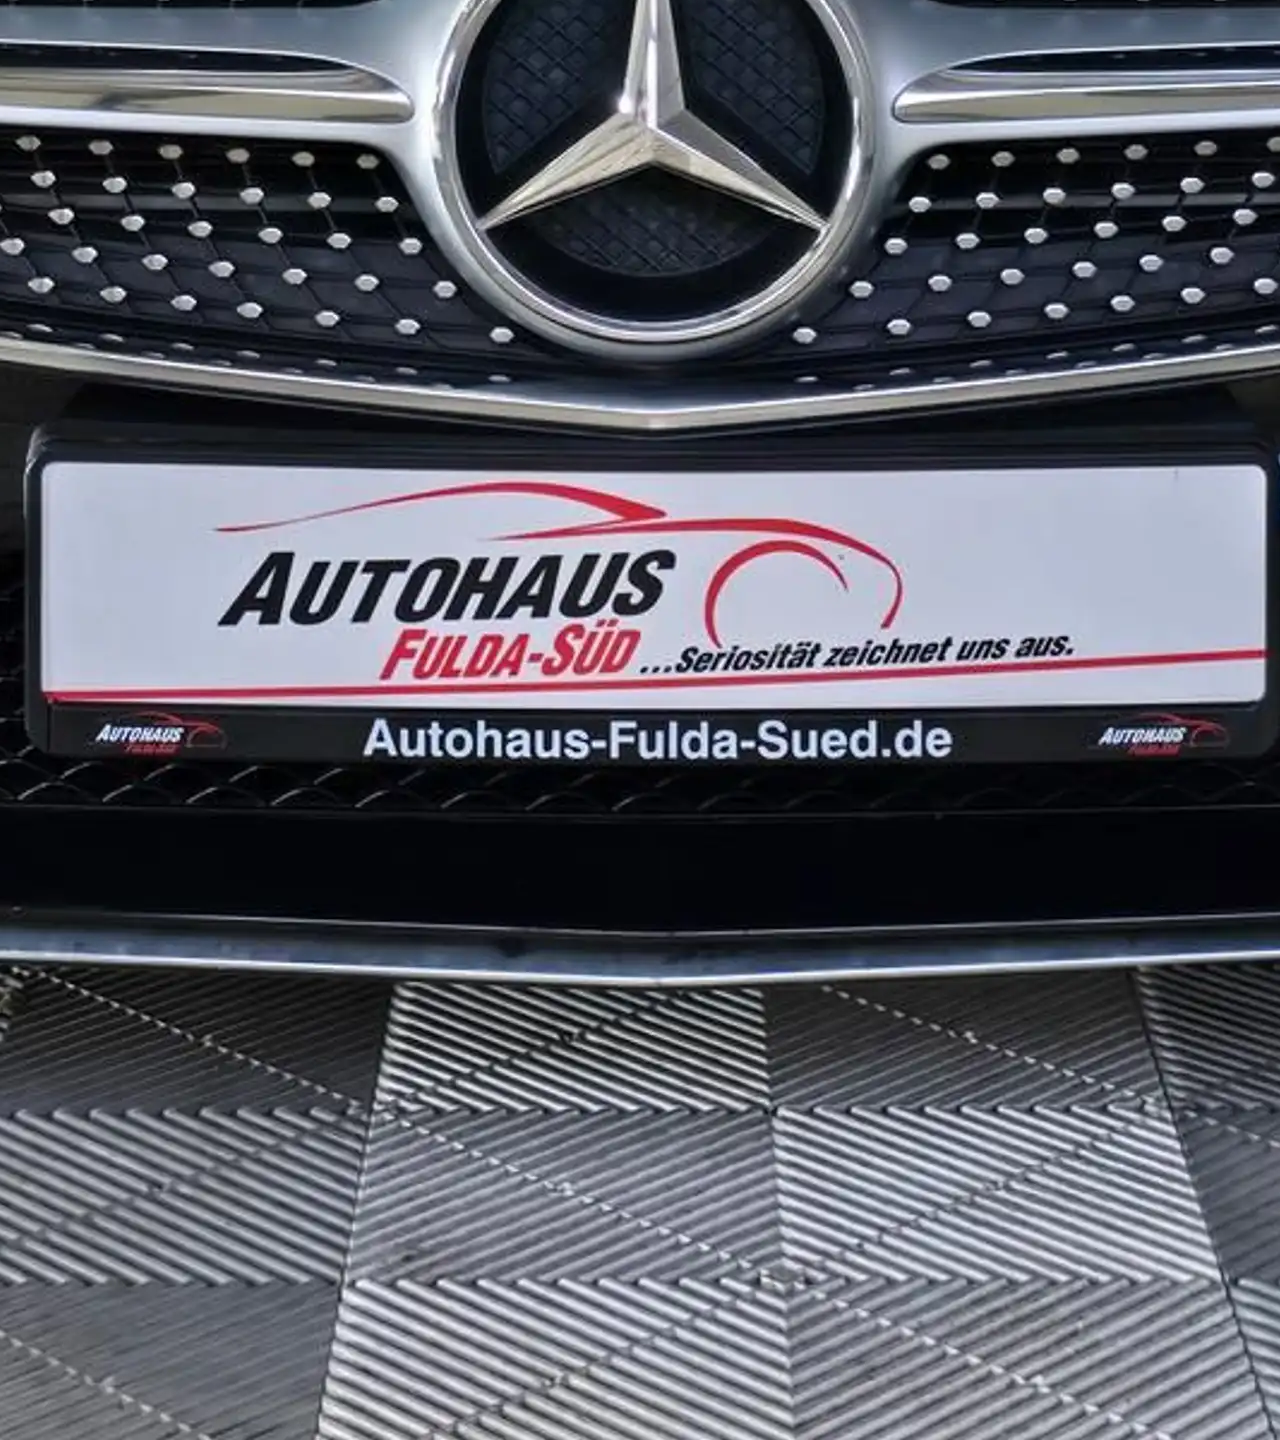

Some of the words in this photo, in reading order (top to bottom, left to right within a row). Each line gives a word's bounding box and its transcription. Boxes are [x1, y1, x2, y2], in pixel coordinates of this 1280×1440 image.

[217, 549, 677, 626] AUTOHAUS
[380, 619, 641, 680] FULDA-SÜD
[640, 641, 821, 673] ...Seriosität
[823, 636, 953, 667] zeichnet
[956, 638, 1010, 660] uns
[1015, 635, 1074, 658] aus.
[95, 723, 185, 742] AUTOHAUS
[363, 718, 952, 759] Autohaus-Fulda-Sued.de
